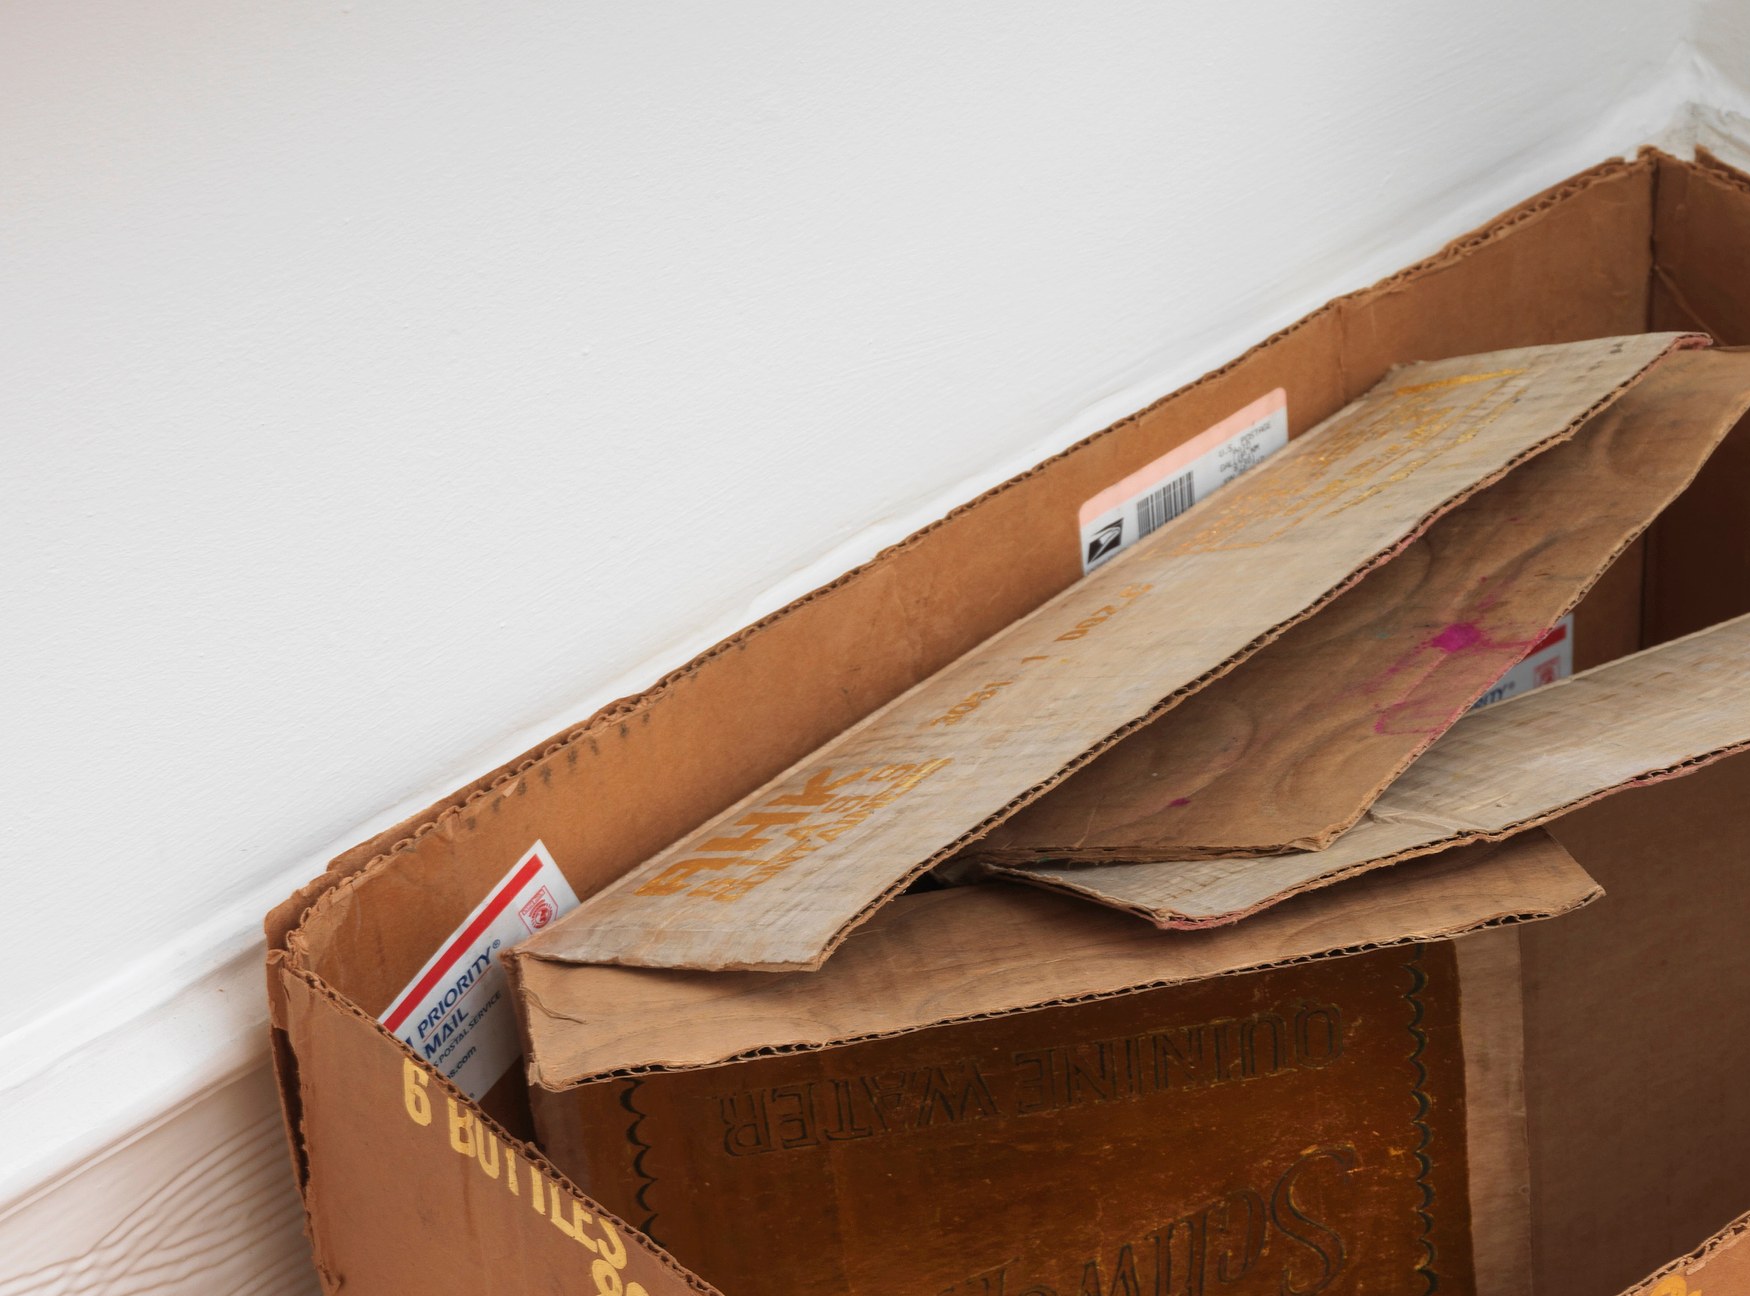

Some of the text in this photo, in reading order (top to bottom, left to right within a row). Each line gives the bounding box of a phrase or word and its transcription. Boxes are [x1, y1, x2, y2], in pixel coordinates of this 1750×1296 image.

[417, 946, 492, 1039] PRIORITY
[439, 990, 501, 1065] POSTAL SERVICE
[422, 1008, 469, 1059] MAIL
[400, 1058, 433, 1128] 6
[720, 1002, 1346, 1159] QUININE WATER
